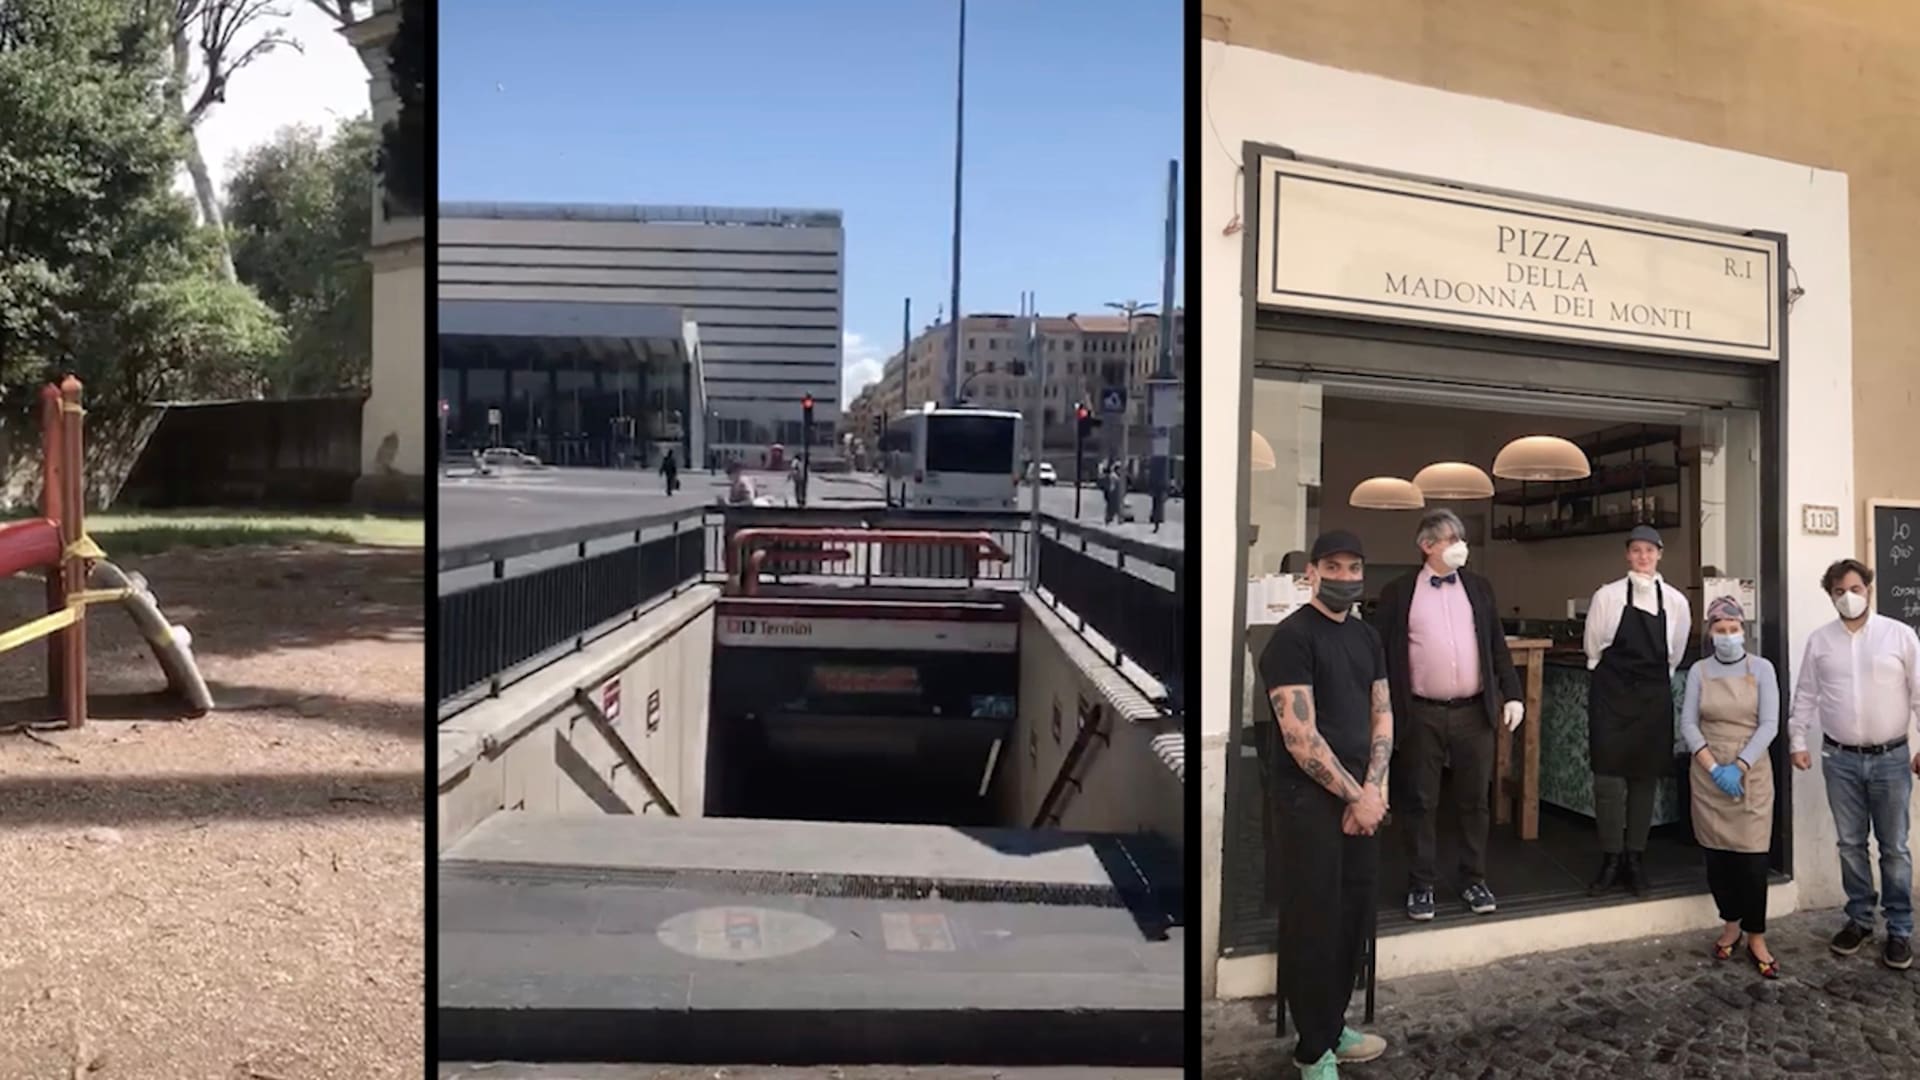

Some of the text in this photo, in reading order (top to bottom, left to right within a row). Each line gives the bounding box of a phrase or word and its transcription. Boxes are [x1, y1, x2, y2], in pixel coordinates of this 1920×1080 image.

[1497, 225, 1598, 266] PIZZA
[1506, 262, 1589, 292] DELLA
[1723, 257, 1753, 279] R.I
[1384, 273, 1693, 330] MADONNA DEI MONTI
[1810, 512, 1833, 528] 110
[761, 620, 812, 636] Termini
